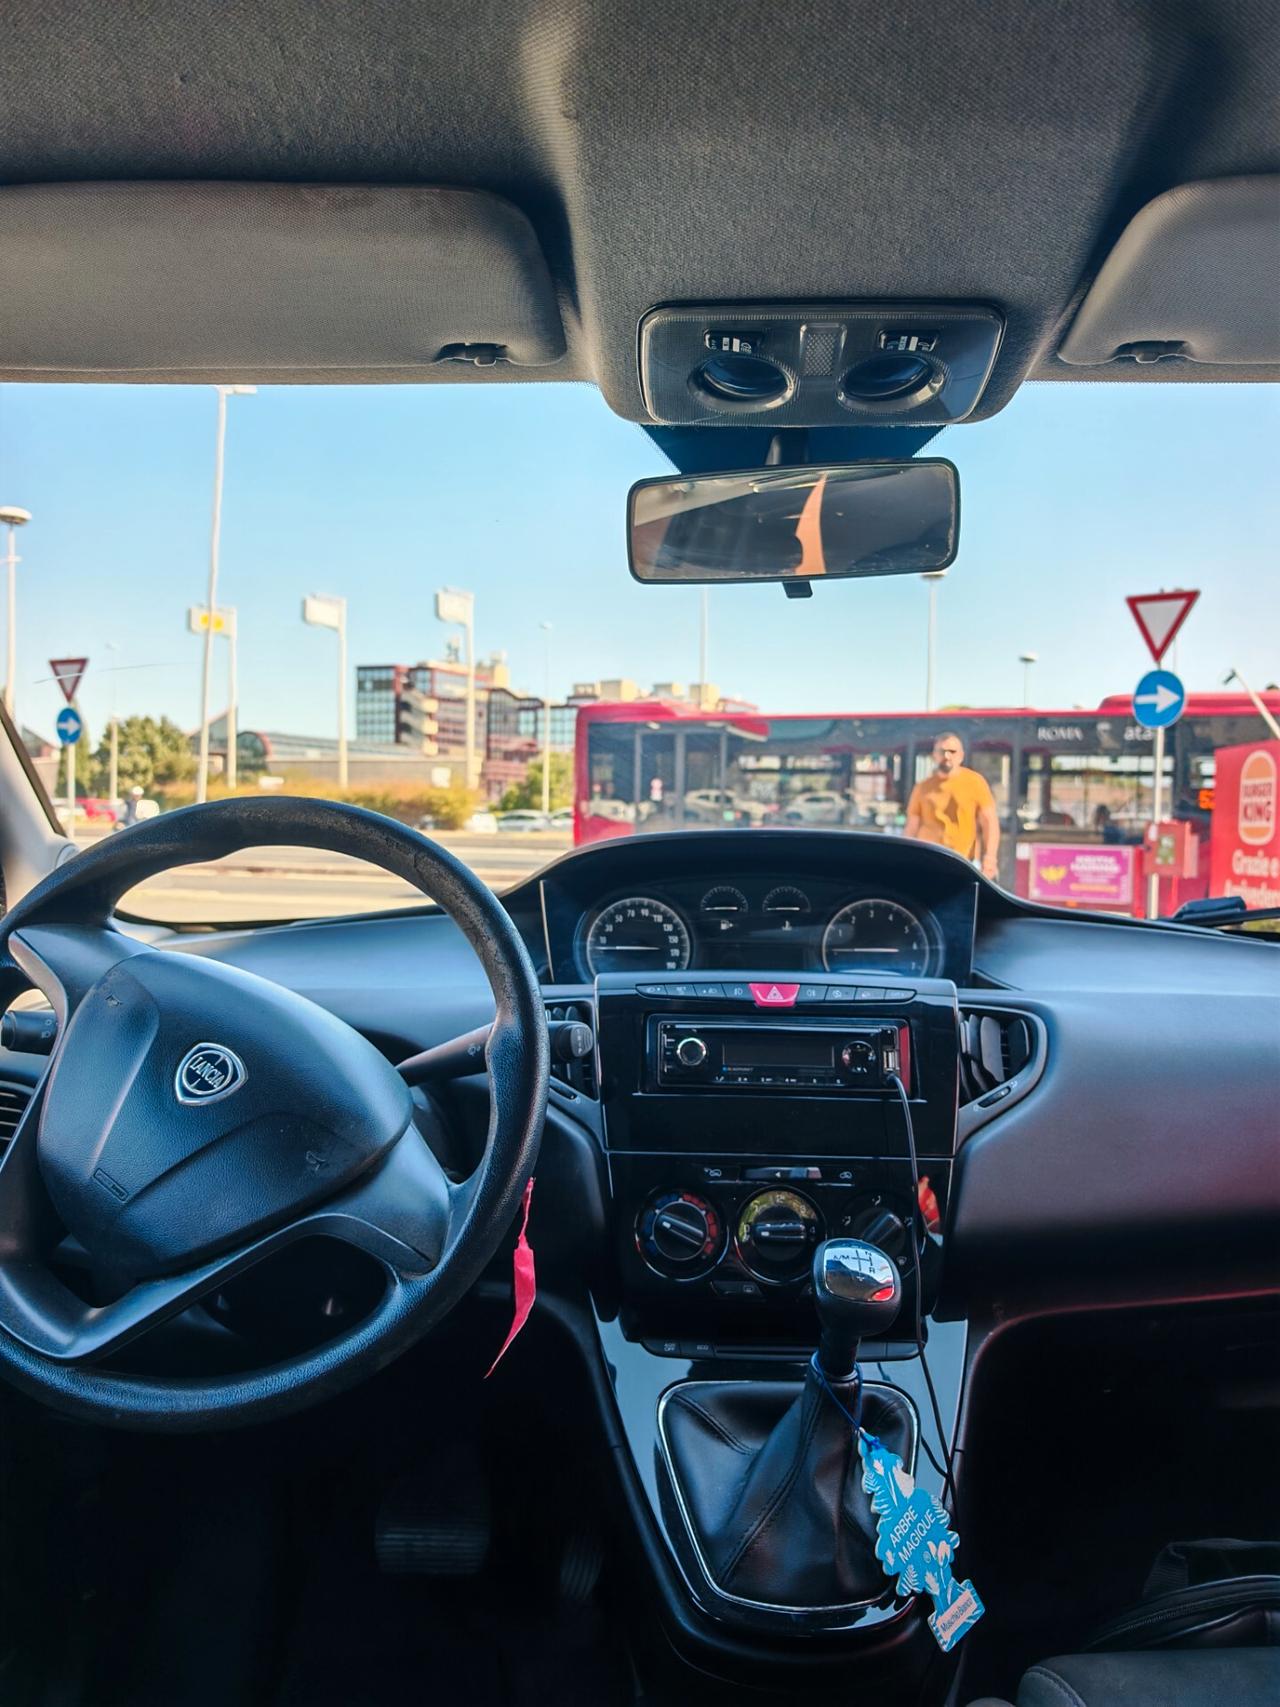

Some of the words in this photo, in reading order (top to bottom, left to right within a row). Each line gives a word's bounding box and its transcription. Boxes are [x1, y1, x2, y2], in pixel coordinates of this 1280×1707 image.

[1124, 725, 1155, 741] ata
[1242, 782, 1272, 797] BURGER
[1242, 800, 1272, 823] KING
[189, 1056, 226, 1089] LANCIA
[890, 1505, 918, 1548] ARBRE
[898, 1508, 936, 1564] MAGIQUE
